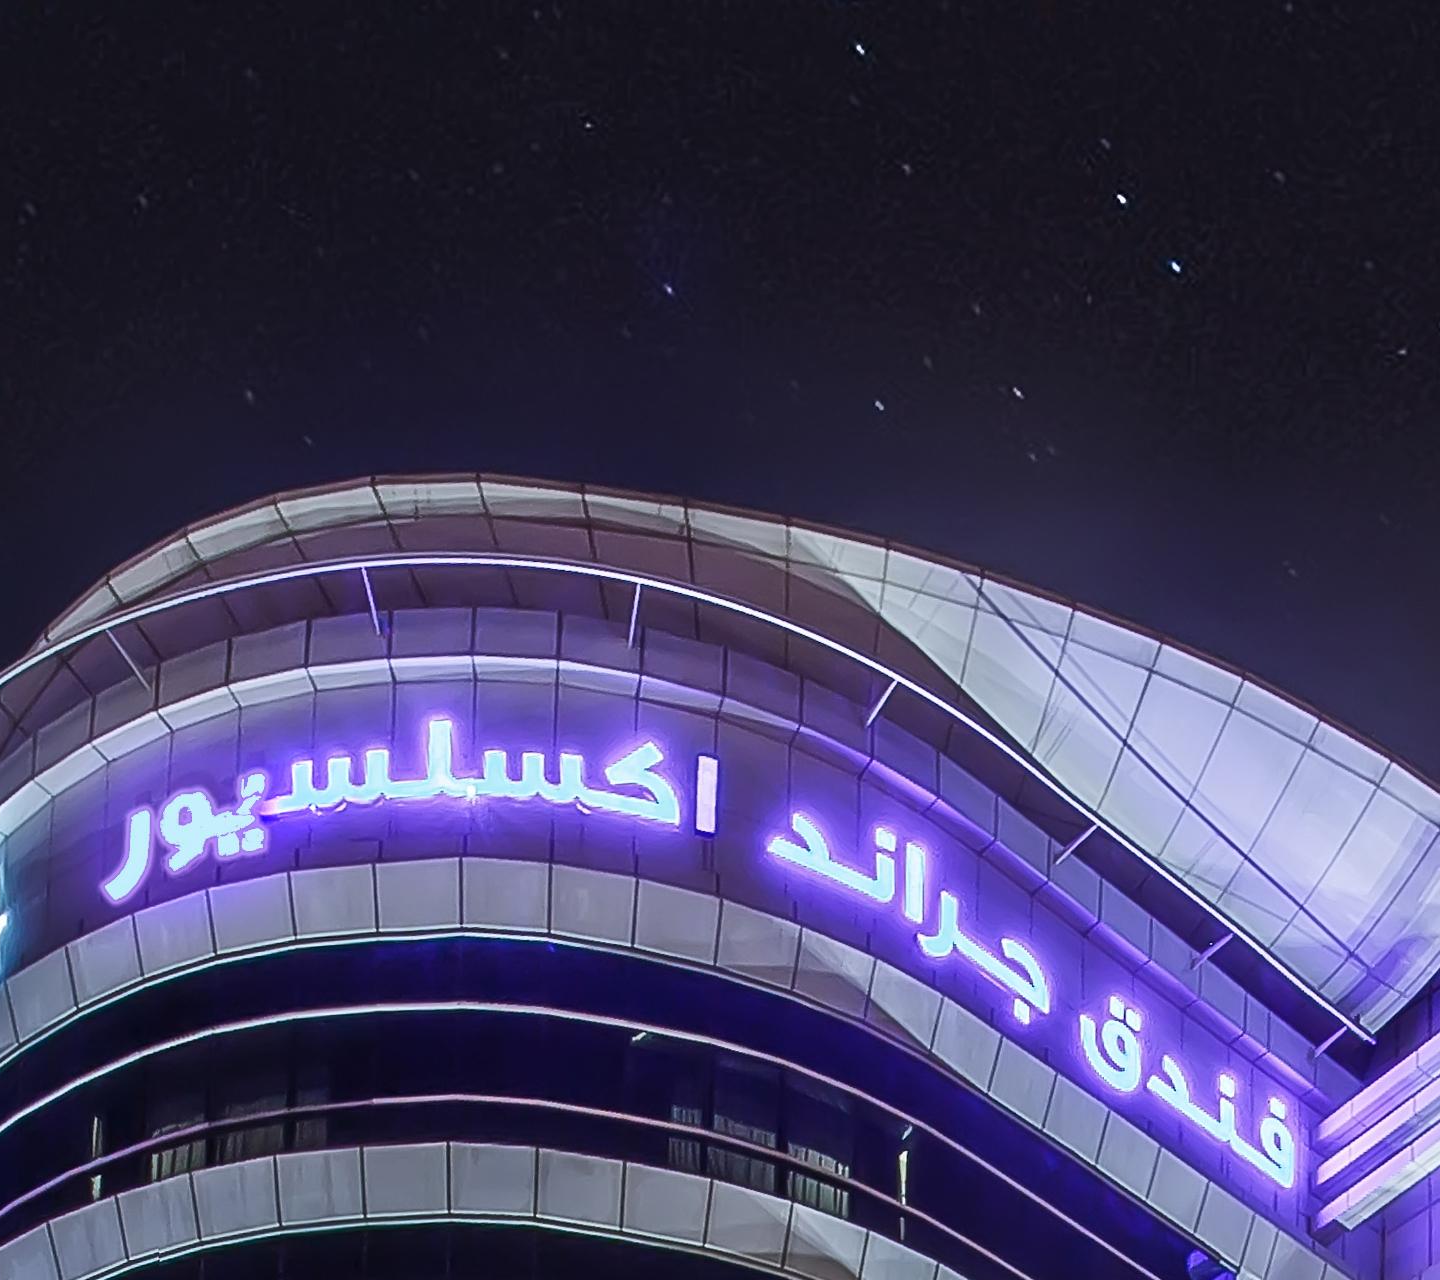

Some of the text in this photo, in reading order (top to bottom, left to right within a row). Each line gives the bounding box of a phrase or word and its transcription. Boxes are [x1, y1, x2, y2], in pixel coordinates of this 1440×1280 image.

[103, 718, 1296, 1190] فندق جراند اكسلسيور
